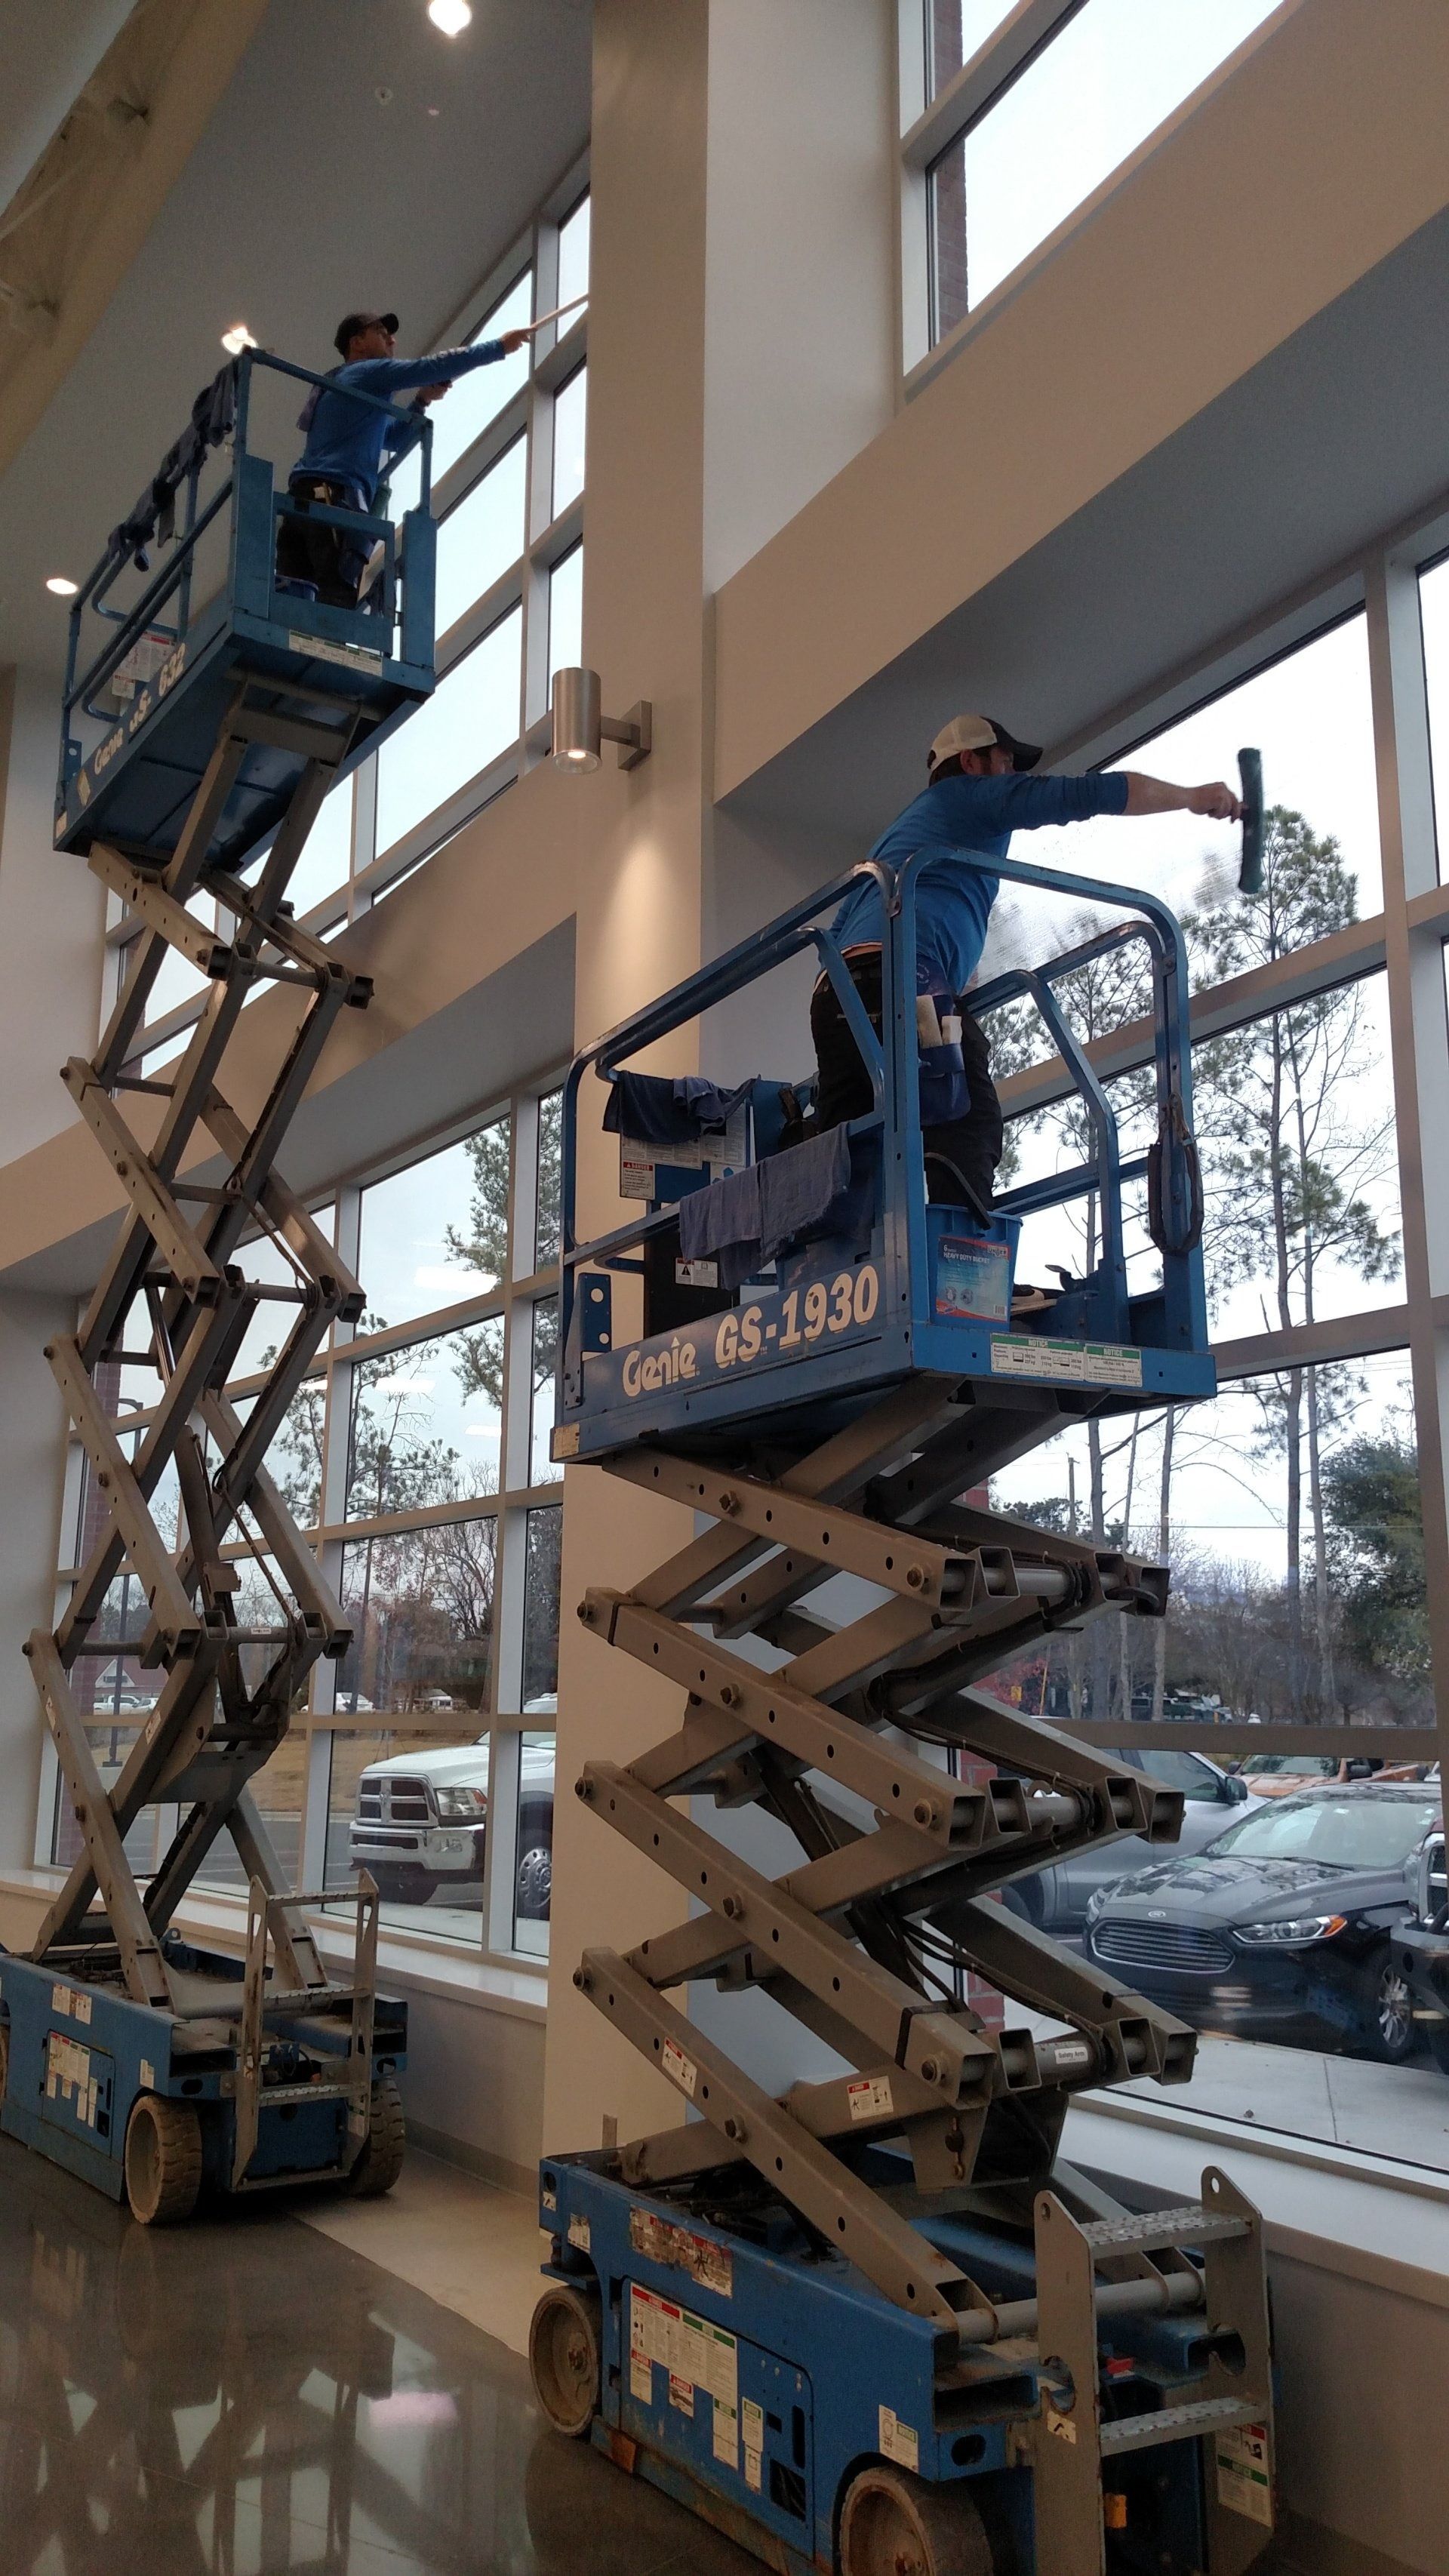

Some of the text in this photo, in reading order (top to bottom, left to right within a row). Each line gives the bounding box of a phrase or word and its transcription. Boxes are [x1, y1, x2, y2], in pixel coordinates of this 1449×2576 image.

[623, 582, 879, 1369] Genie GS-1930
[1028, 1339, 1048, 1349] NOTICE
[1103, 1348, 1123, 1357] NOTICE
